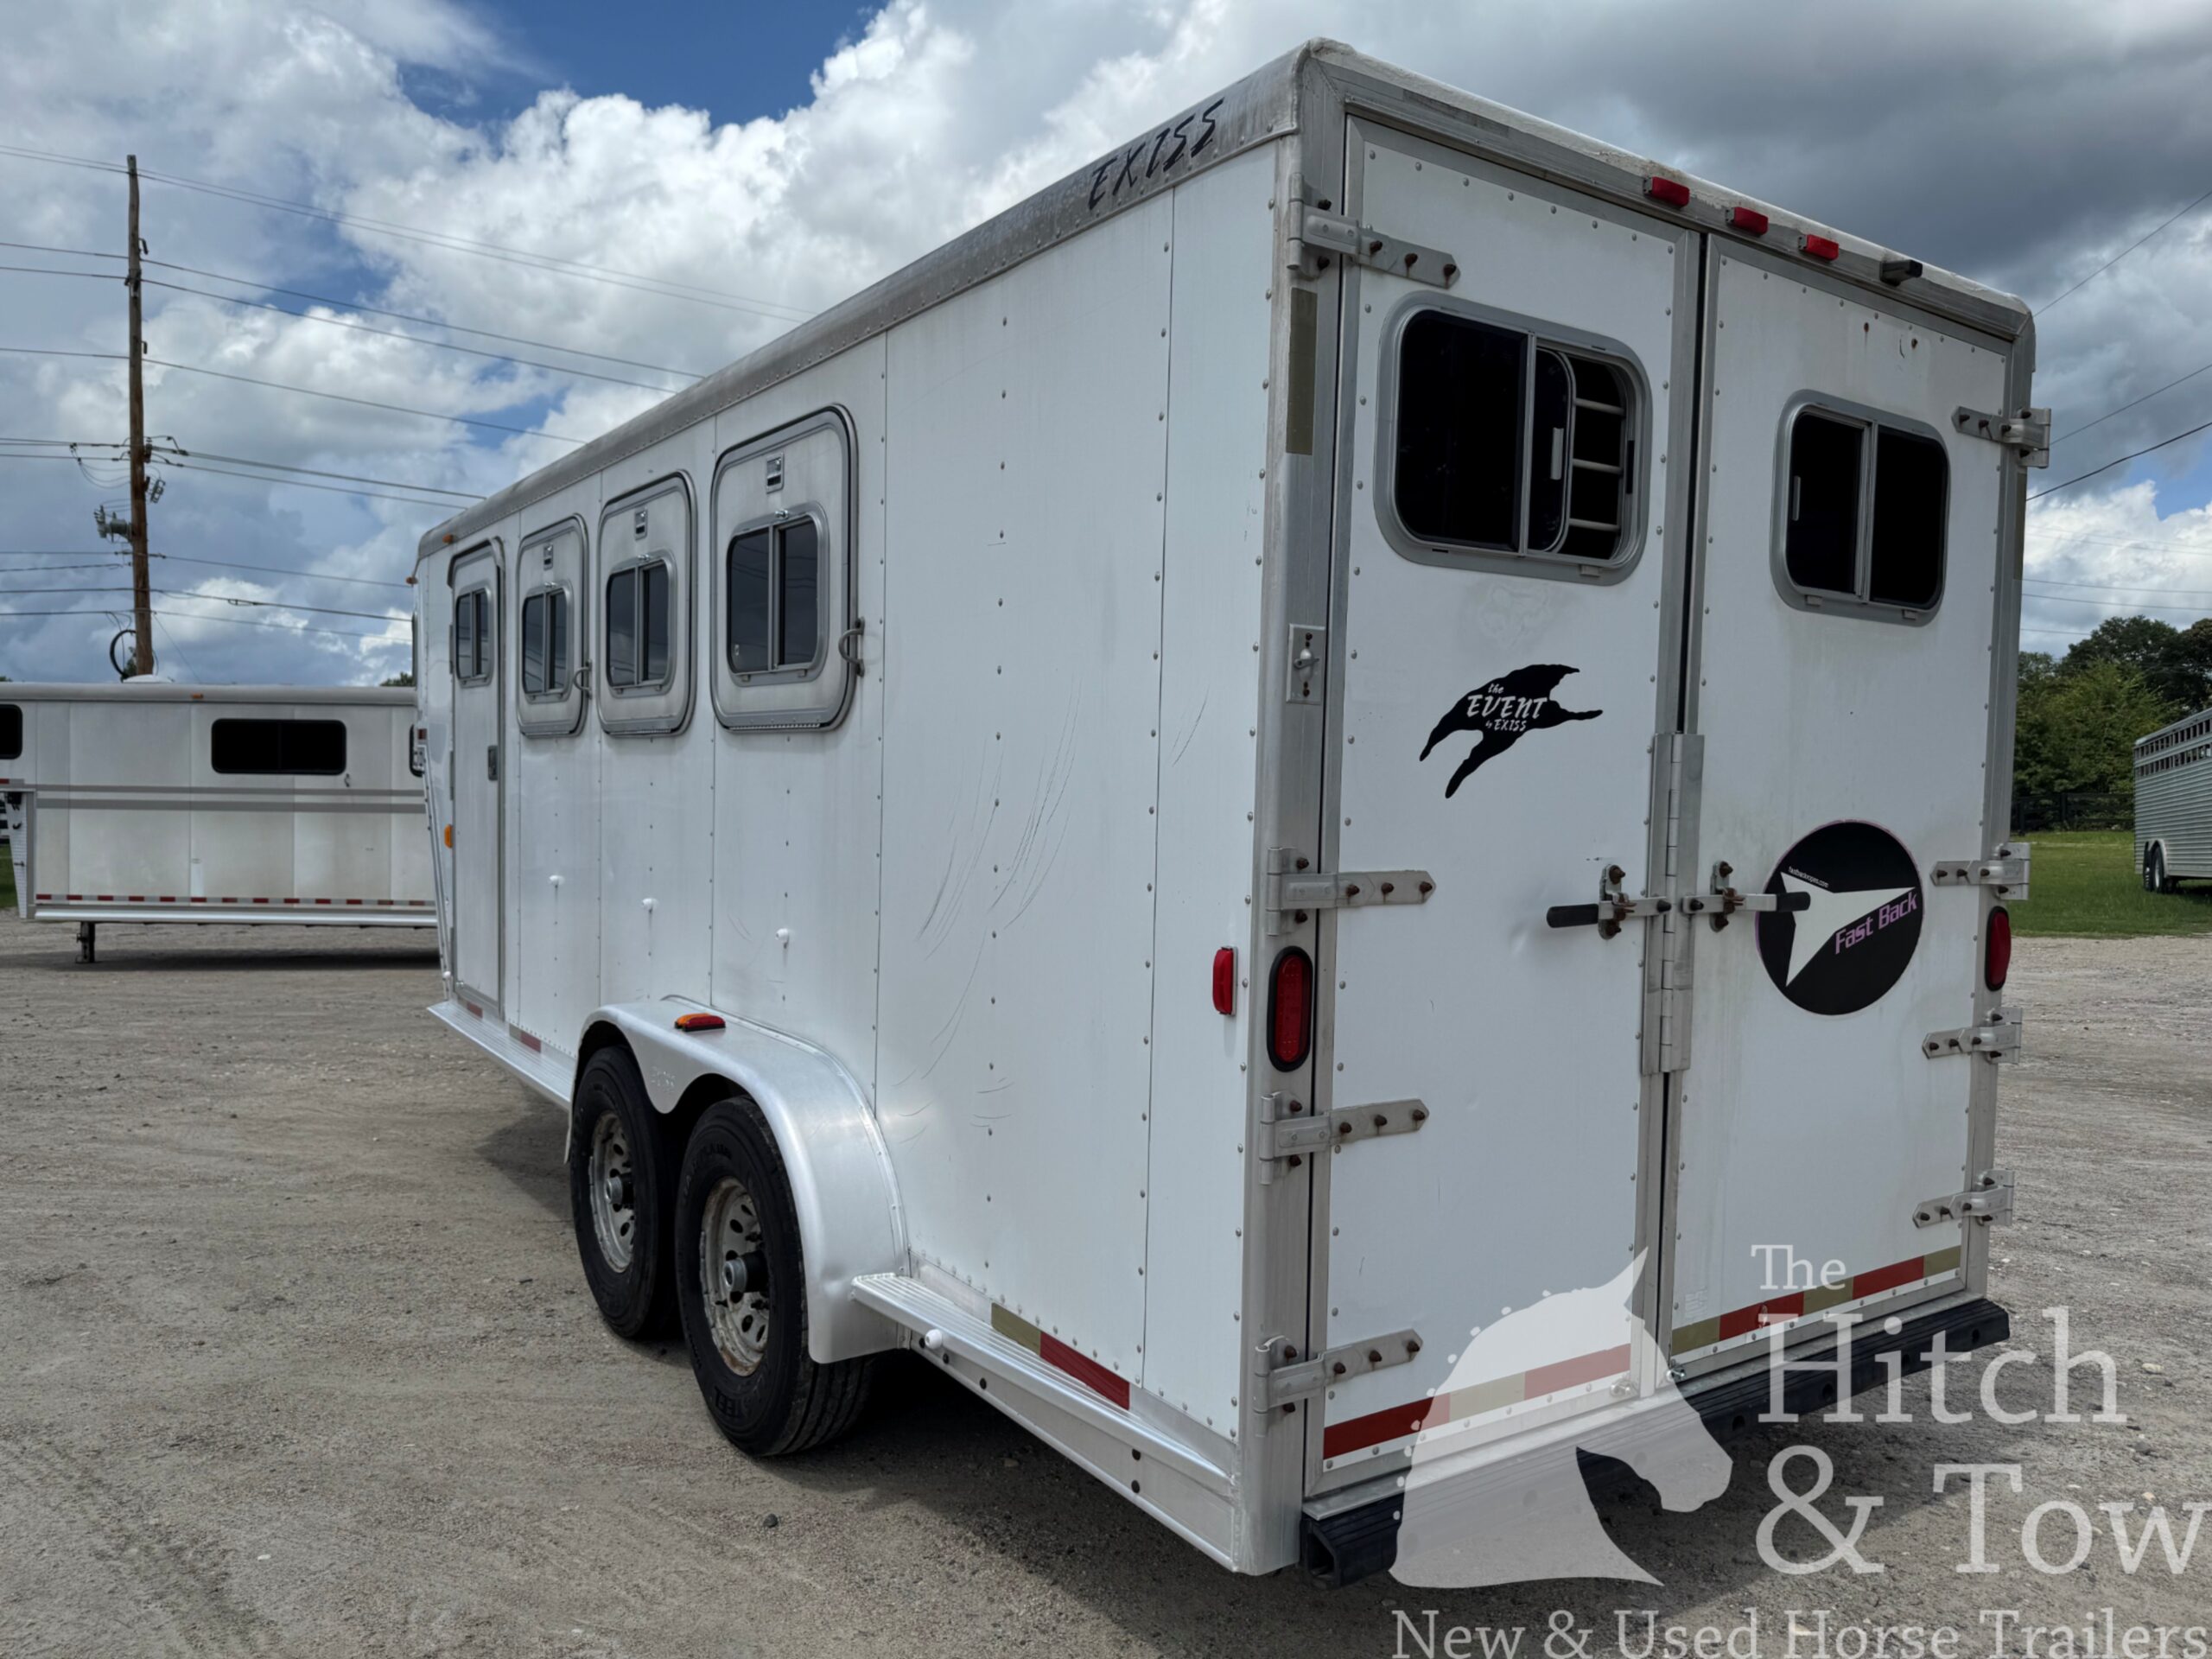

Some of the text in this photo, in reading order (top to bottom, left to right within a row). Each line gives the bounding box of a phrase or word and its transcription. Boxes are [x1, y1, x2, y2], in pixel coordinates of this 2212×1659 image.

[1088, 97, 1225, 210] EXISS
[1487, 683, 1504, 694] the
[1466, 694, 1548, 720] EVENT
[1493, 718, 1528, 732] EXISS
[1834, 891, 1917, 955] Fast Back
